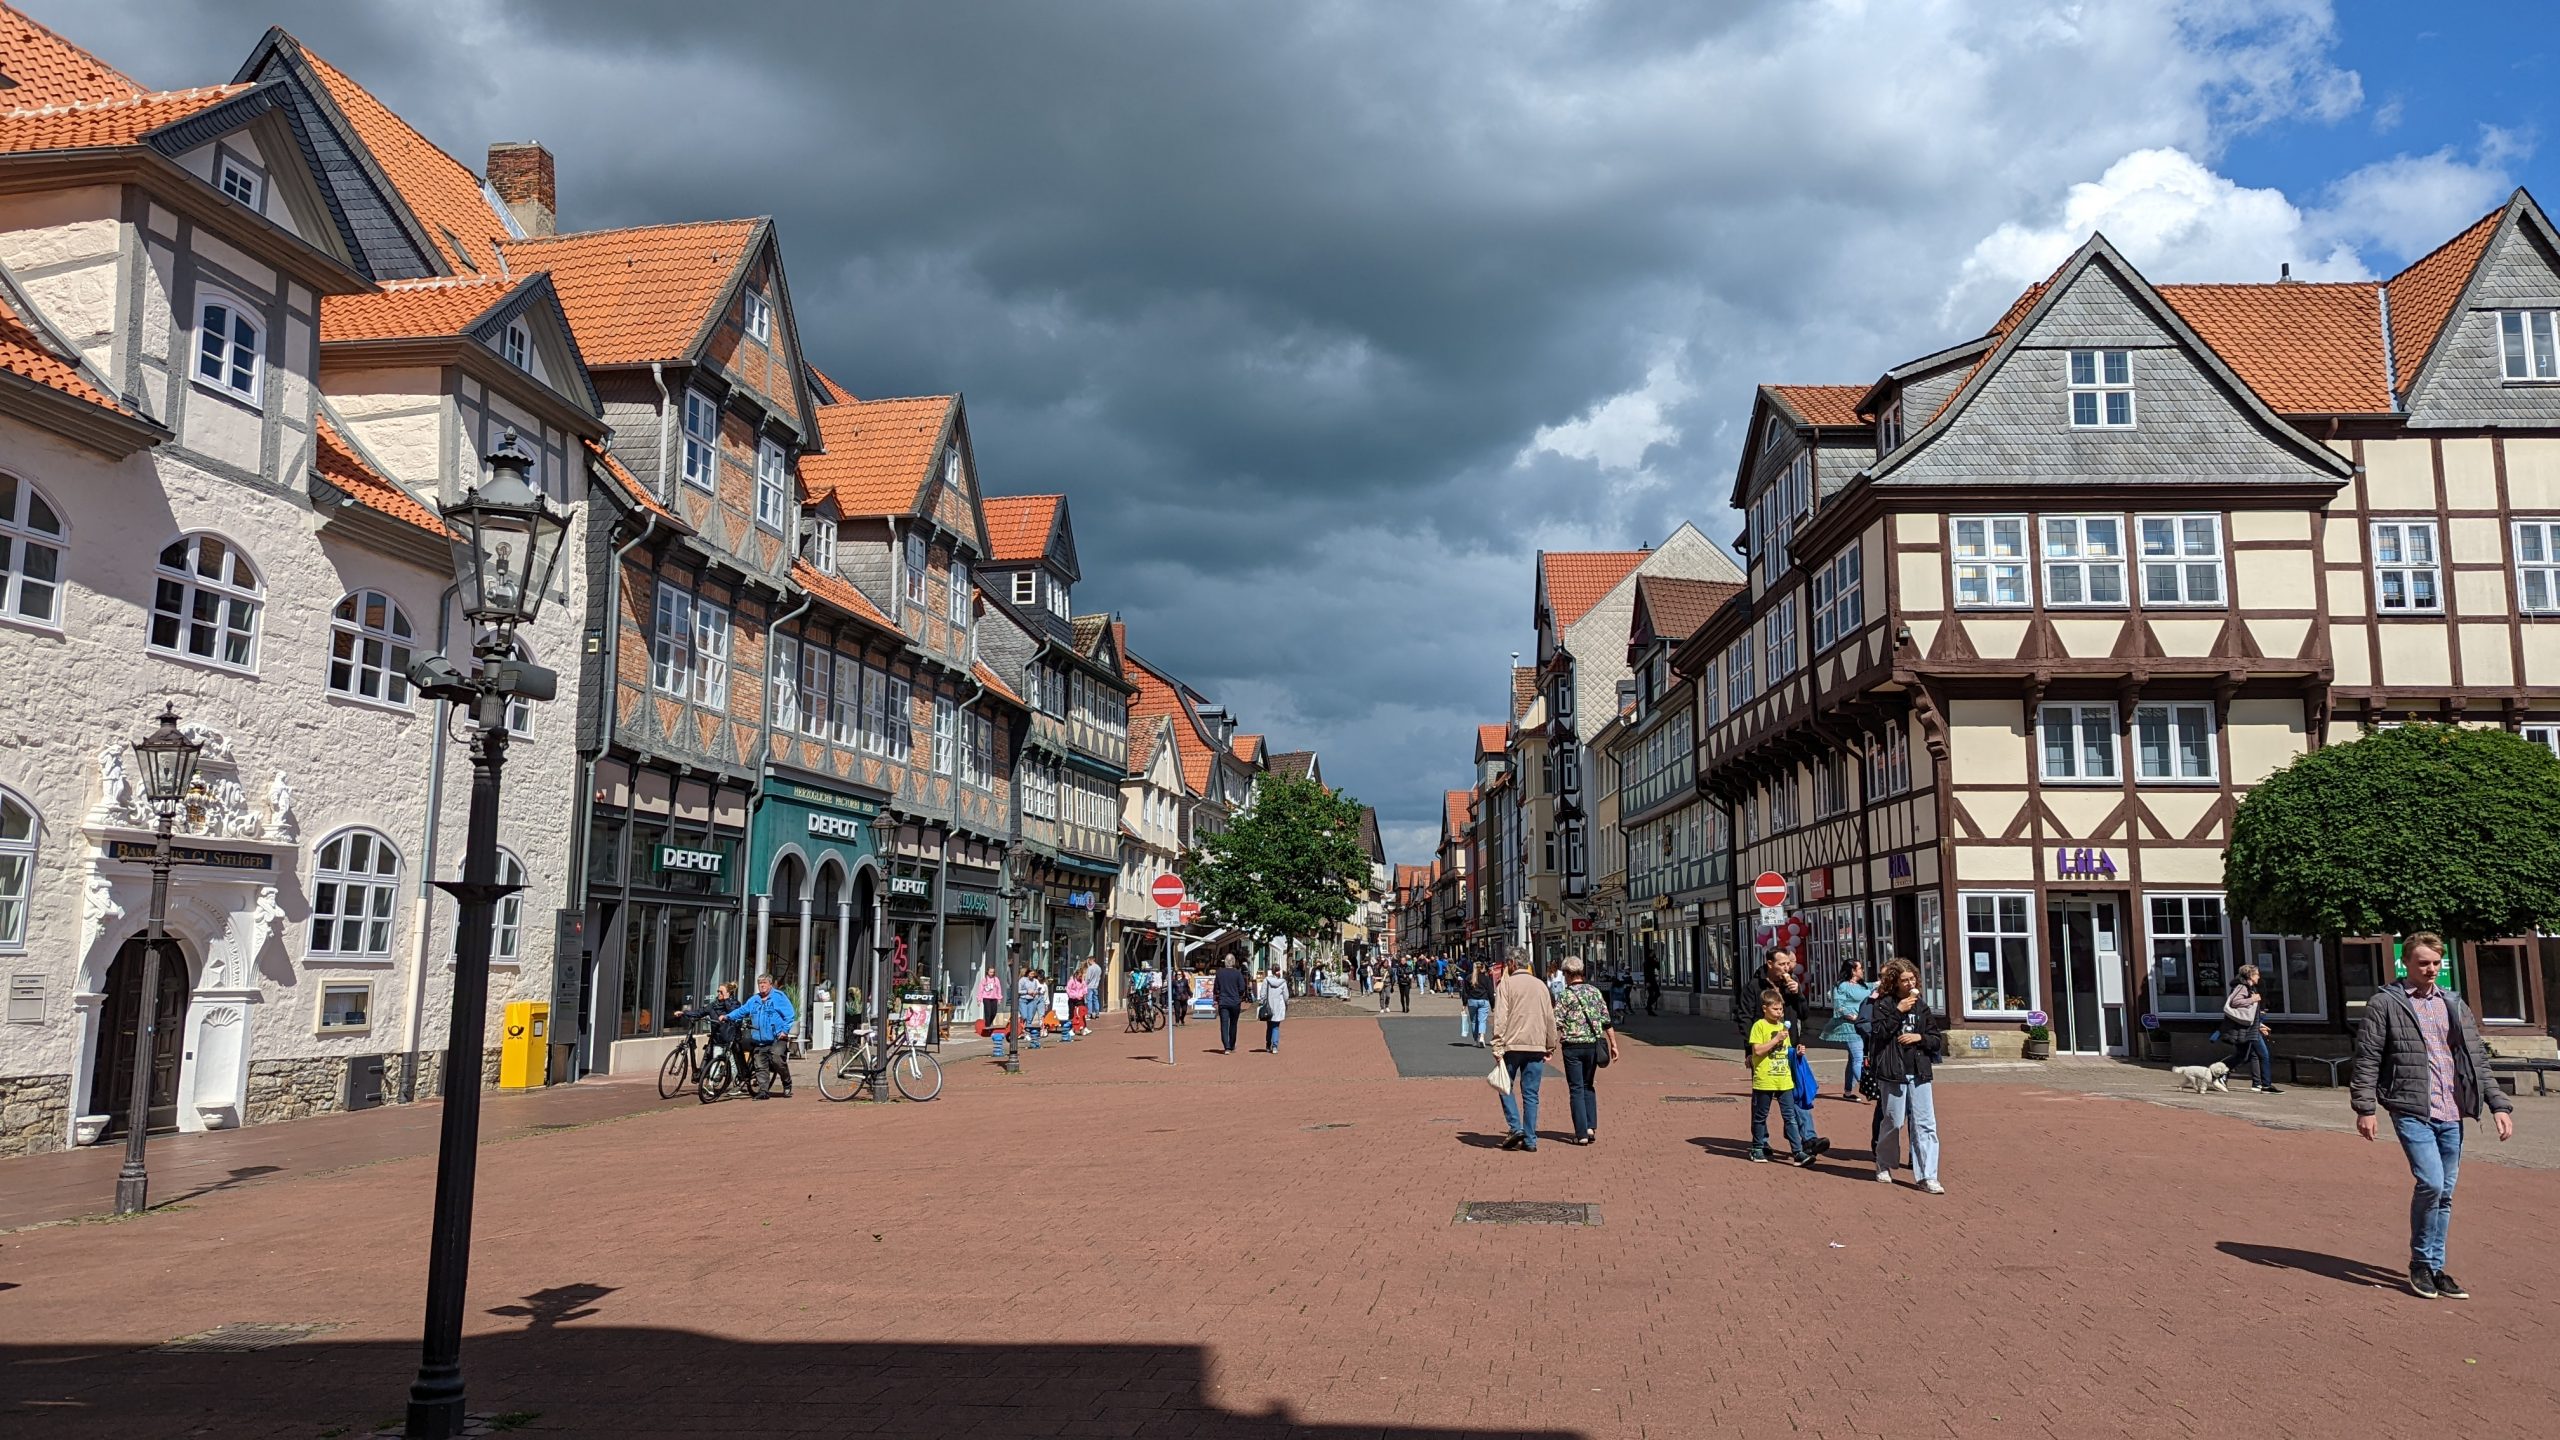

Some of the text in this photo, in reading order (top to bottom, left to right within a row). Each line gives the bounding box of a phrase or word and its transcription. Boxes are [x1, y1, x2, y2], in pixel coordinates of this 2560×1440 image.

[808, 813, 858, 838] DEPOT
[117, 843, 184, 860] BANKUS
[663, 848, 722, 871] DEPOT
[892, 878, 927, 895] DEPOT
[904, 993, 934, 1001] DEPOT
